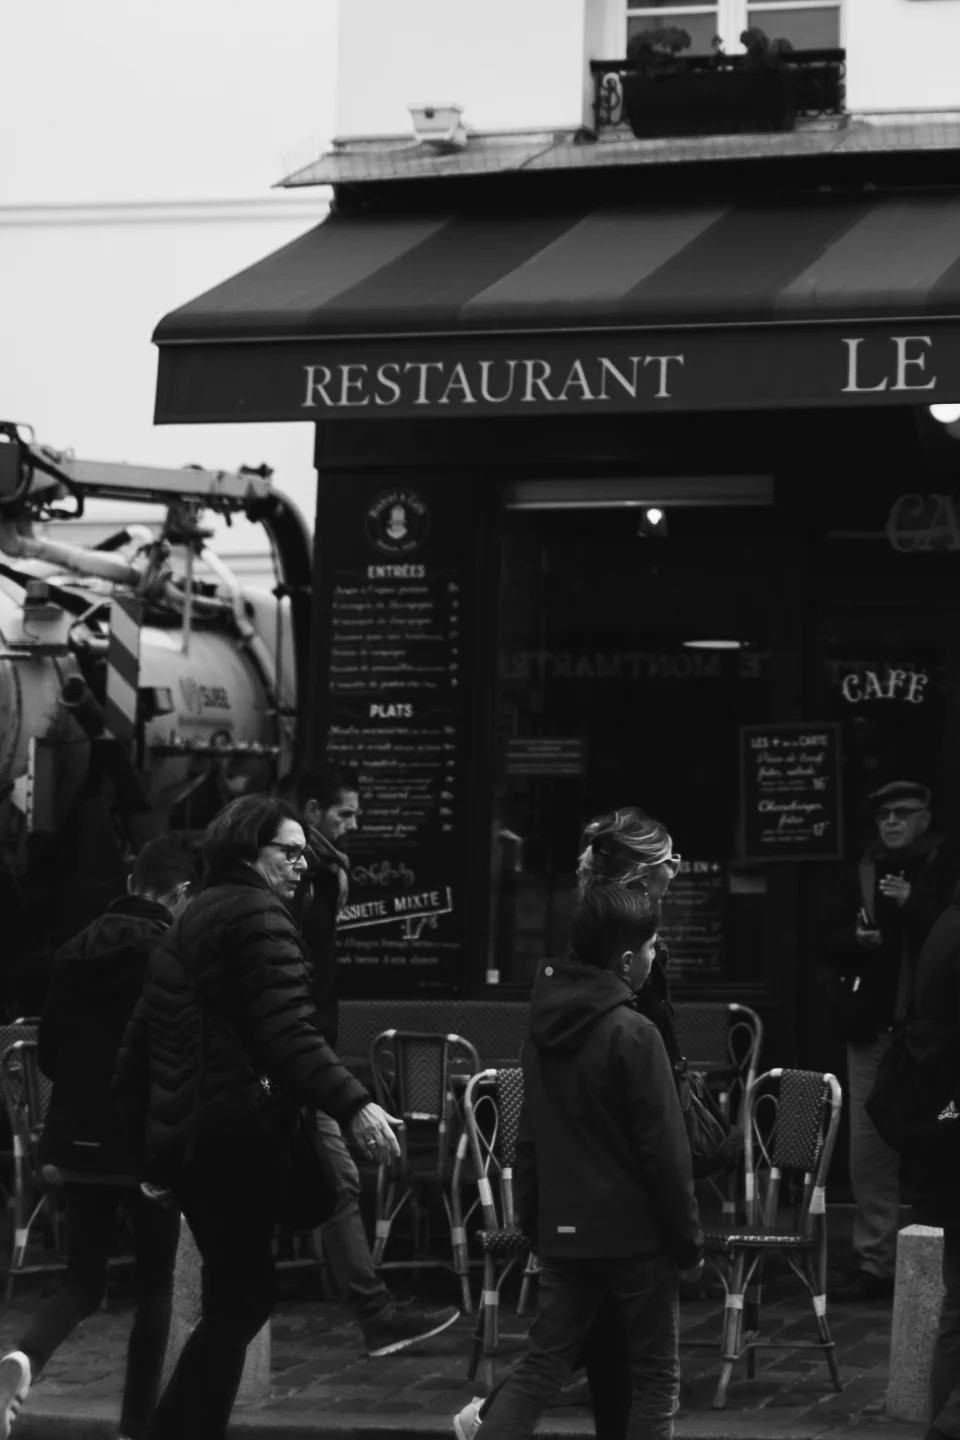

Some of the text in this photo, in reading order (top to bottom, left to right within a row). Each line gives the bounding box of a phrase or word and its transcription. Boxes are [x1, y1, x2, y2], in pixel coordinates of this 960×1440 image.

[302, 354, 684, 407] RESTAURANT
[842, 336, 936, 393] LE
[842, 667, 929, 704] CAFÉ
[369, 703, 413, 718] PLATS
[336, 891, 441, 923] ASSIETTE MIXTE
